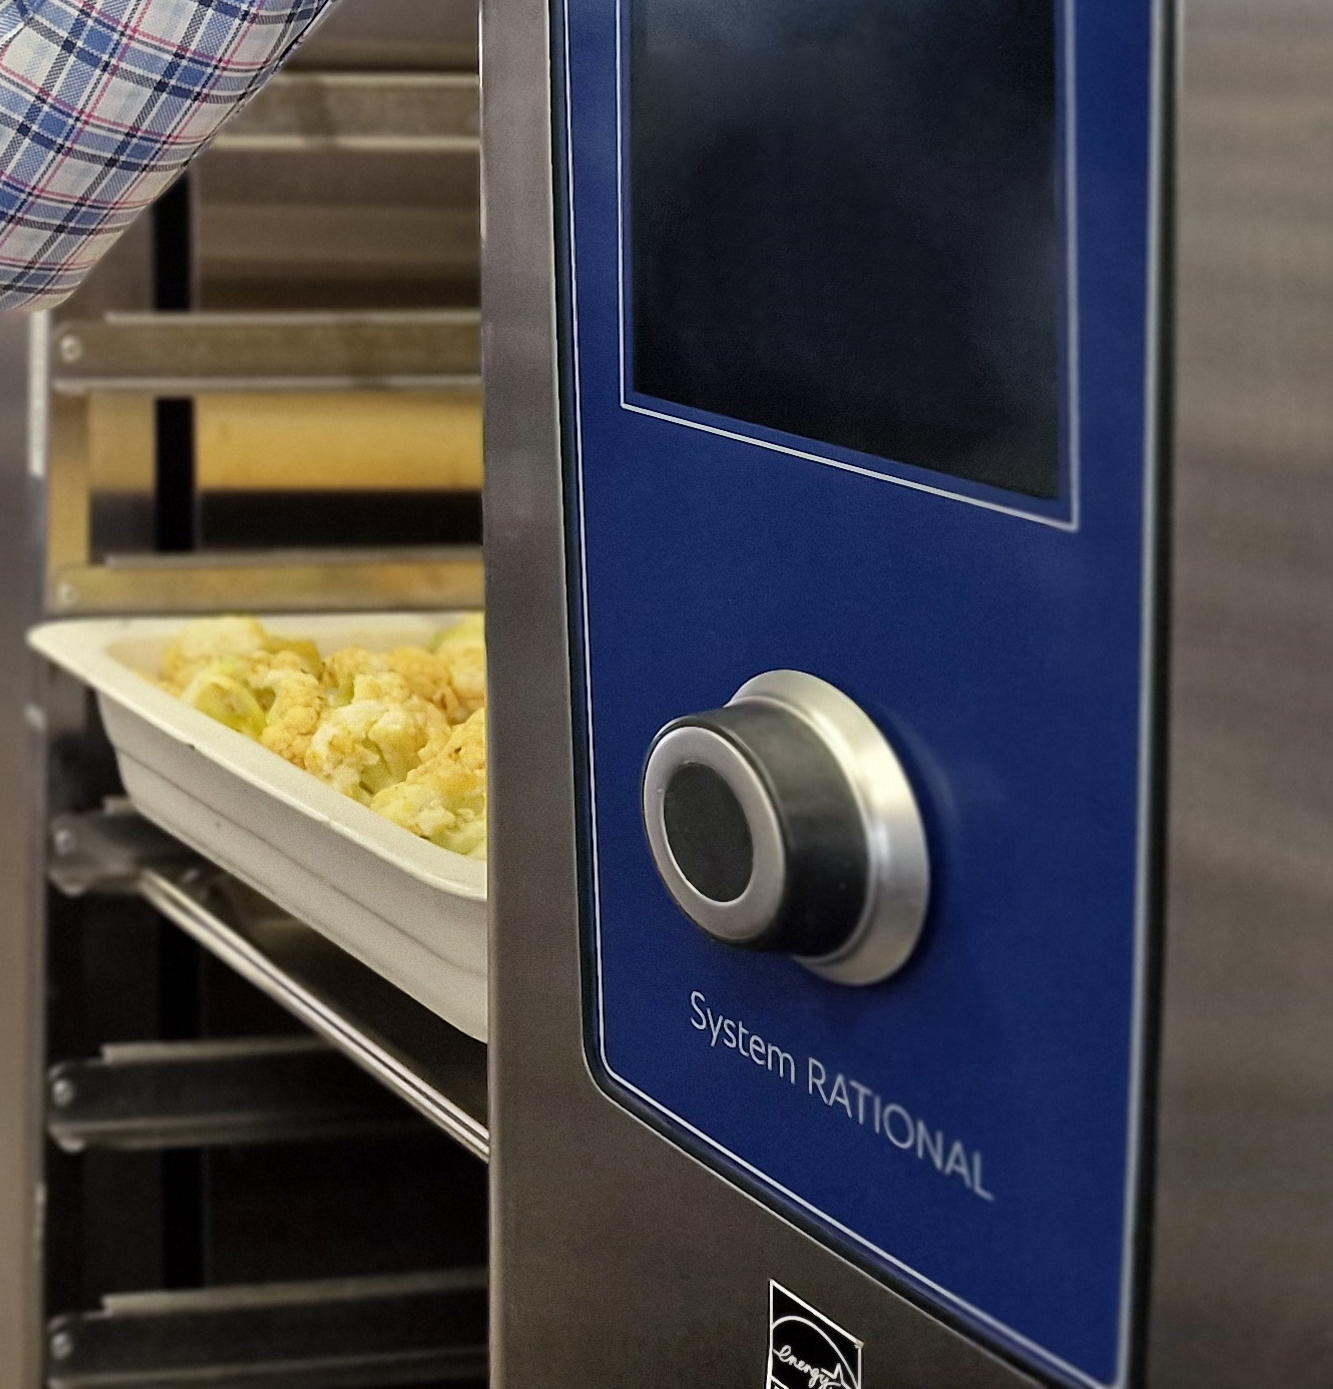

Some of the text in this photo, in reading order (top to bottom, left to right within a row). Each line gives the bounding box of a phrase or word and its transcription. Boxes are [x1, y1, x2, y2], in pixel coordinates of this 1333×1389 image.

[690, 990, 994, 1202] System RATIONAL
[773, 1344, 830, 1389] energy
